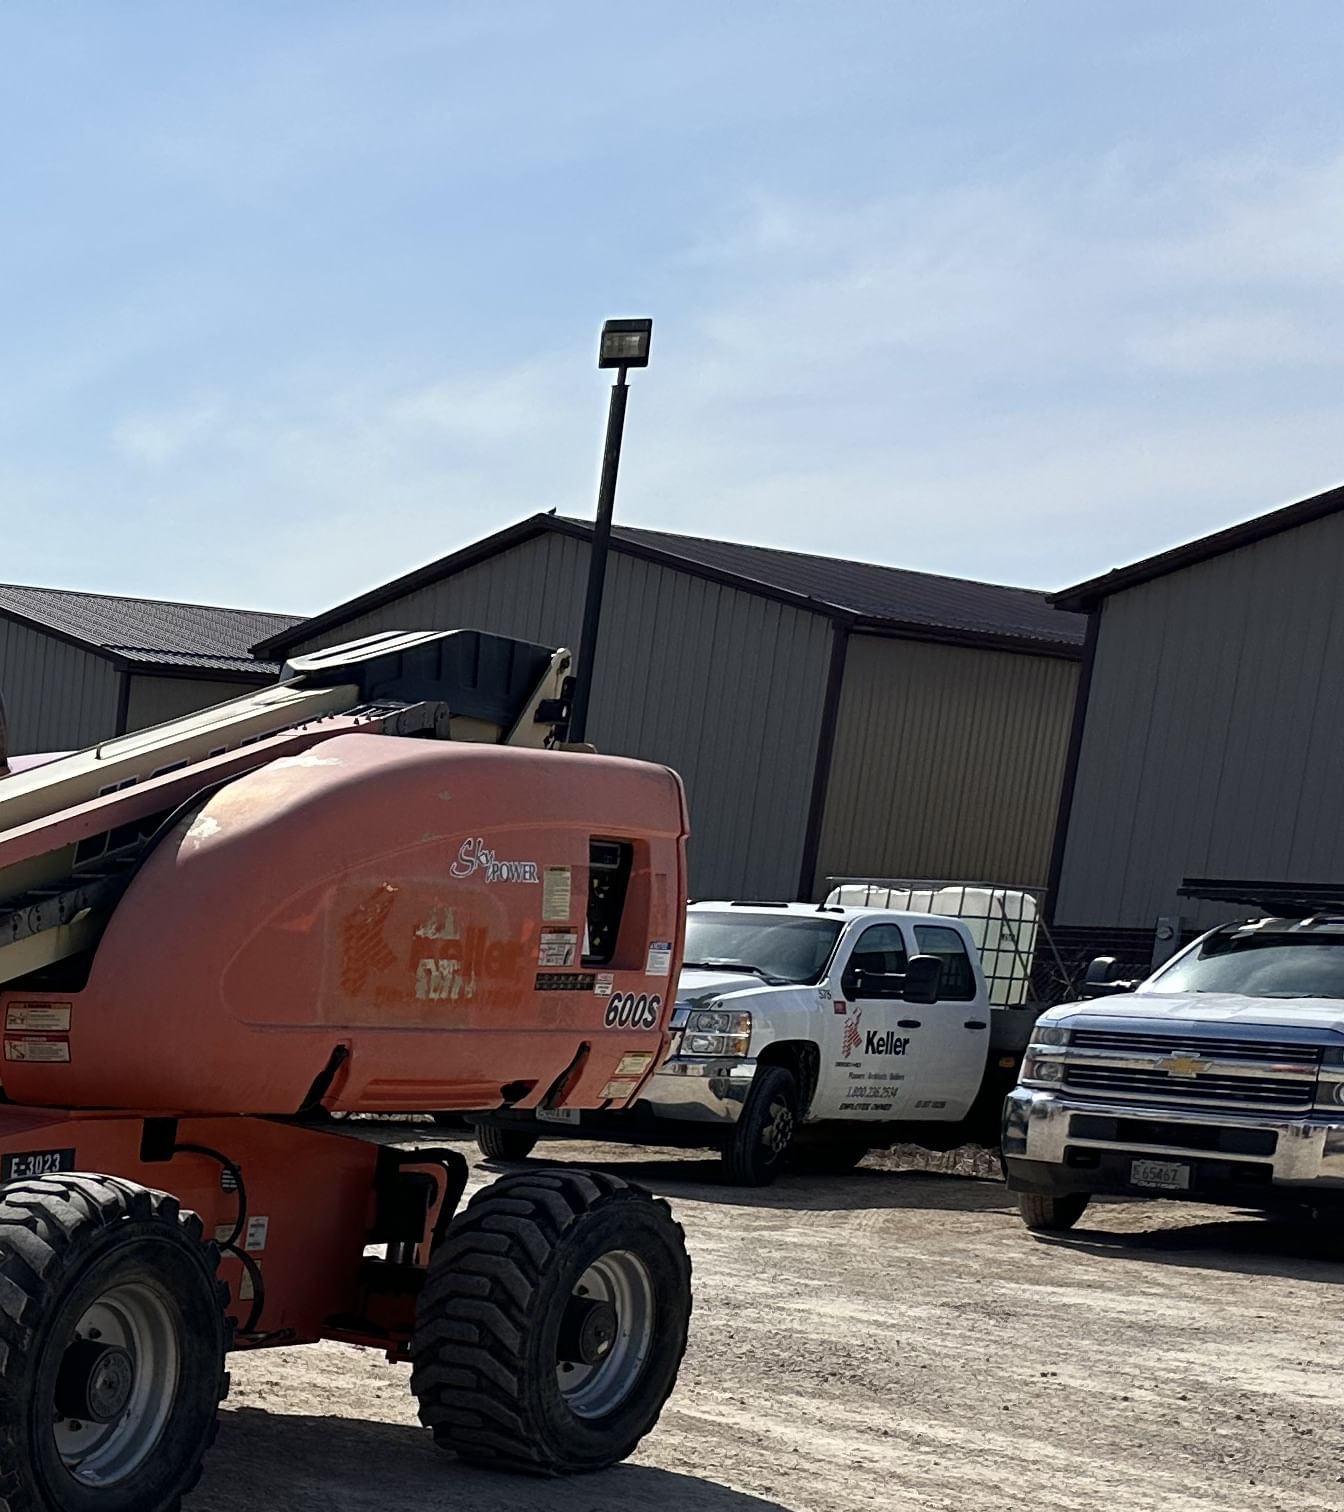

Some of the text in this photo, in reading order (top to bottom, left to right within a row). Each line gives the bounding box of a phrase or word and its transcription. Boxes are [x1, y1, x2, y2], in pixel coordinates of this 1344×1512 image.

[490, 861, 539, 883] POWER
[604, 991, 662, 1031] 600S
[865, 1030, 910, 1056] Keller
[11, 1153, 61, 1179] E-3023
